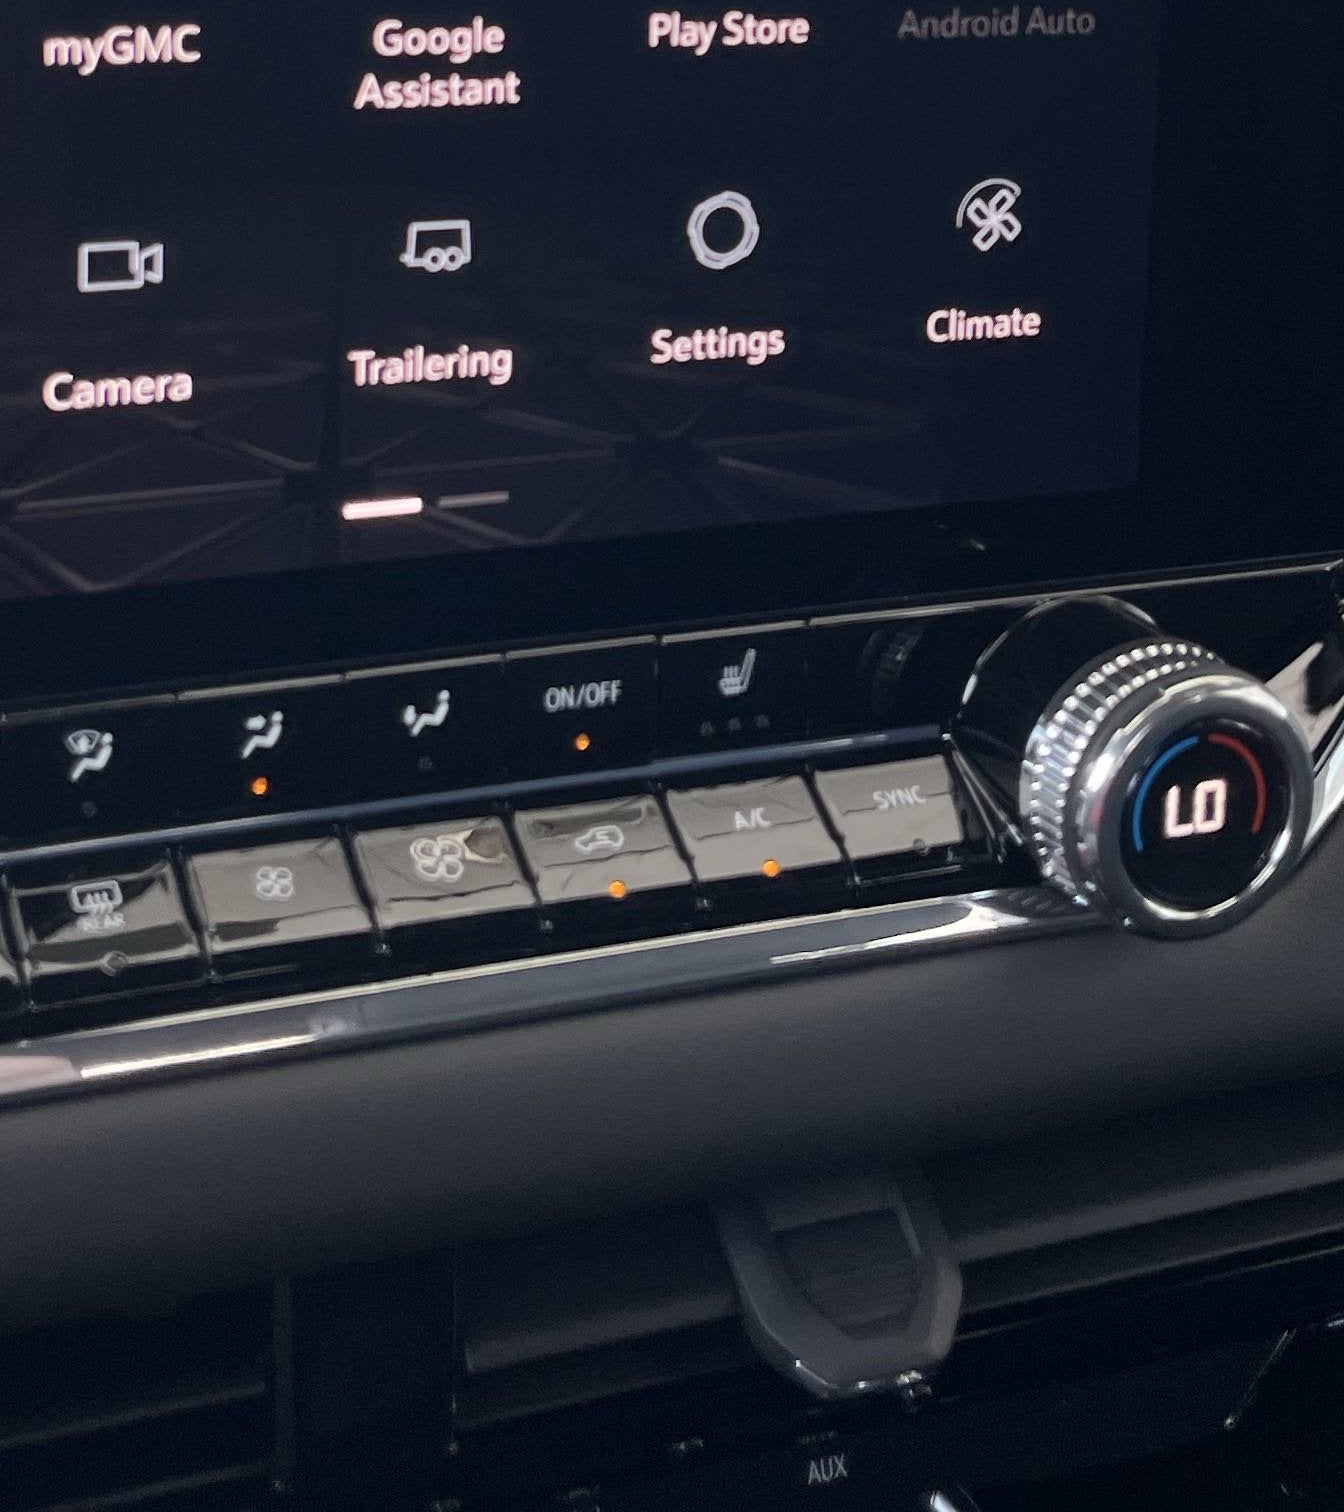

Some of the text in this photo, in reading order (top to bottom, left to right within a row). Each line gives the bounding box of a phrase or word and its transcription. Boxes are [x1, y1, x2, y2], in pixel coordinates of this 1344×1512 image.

[372, 16, 506, 64] Google
[648, 10, 809, 56] Play Store
[898, 4, 1096, 39] Android Auto
[42, 23, 202, 76] myGMC
[353, 71, 521, 110] Assistant
[926, 308, 1042, 344] Climate
[650, 327, 785, 365] Settings
[347, 344, 513, 387] Trailering
[42, 371, 194, 412] Camera
[544, 679, 623, 712] ON/OFF
[873, 785, 927, 810] SYNC
[1163, 777, 1227, 839] LO
[734, 807, 772, 832] A/C
[807, 1453, 848, 1485] AUX
